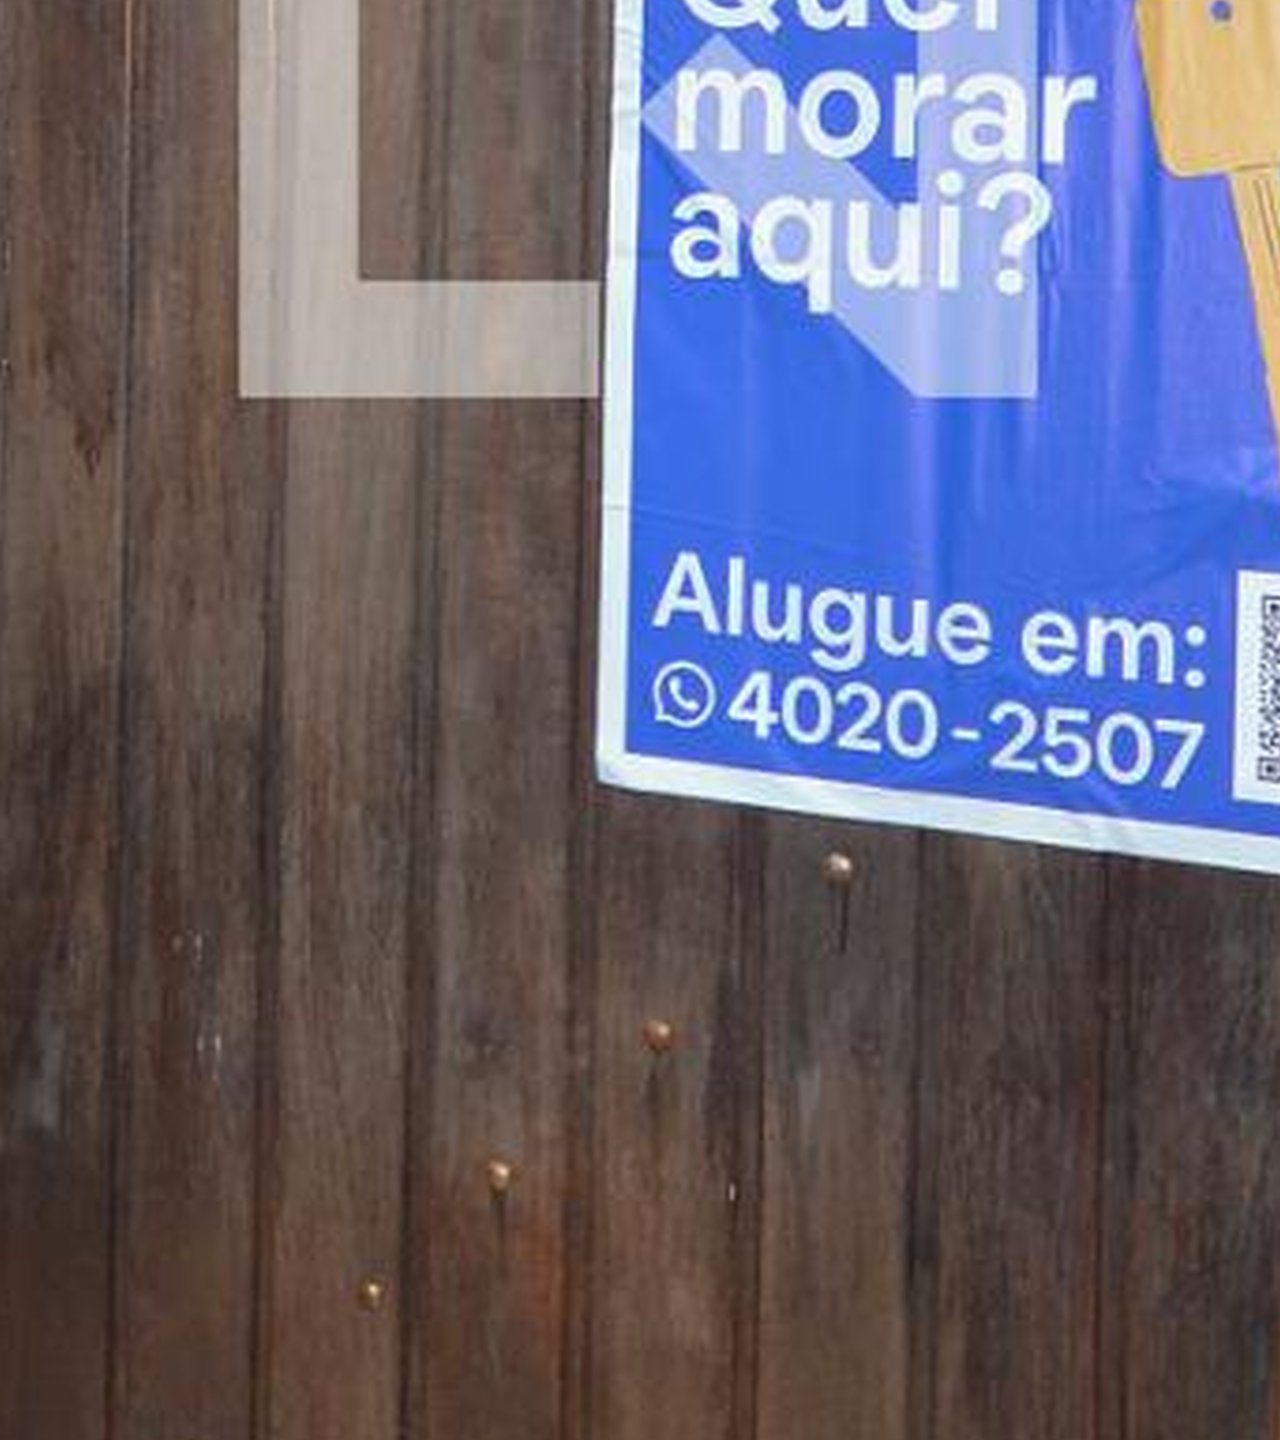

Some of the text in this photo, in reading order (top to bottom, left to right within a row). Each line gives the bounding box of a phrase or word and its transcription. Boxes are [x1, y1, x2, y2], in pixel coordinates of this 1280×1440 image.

[674, 65, 1098, 167] morar
[669, 169, 1053, 314] aqui?
[652, 551, 1207, 689] Alugue em:
[726, 670, 1206, 790] 4020-2507
